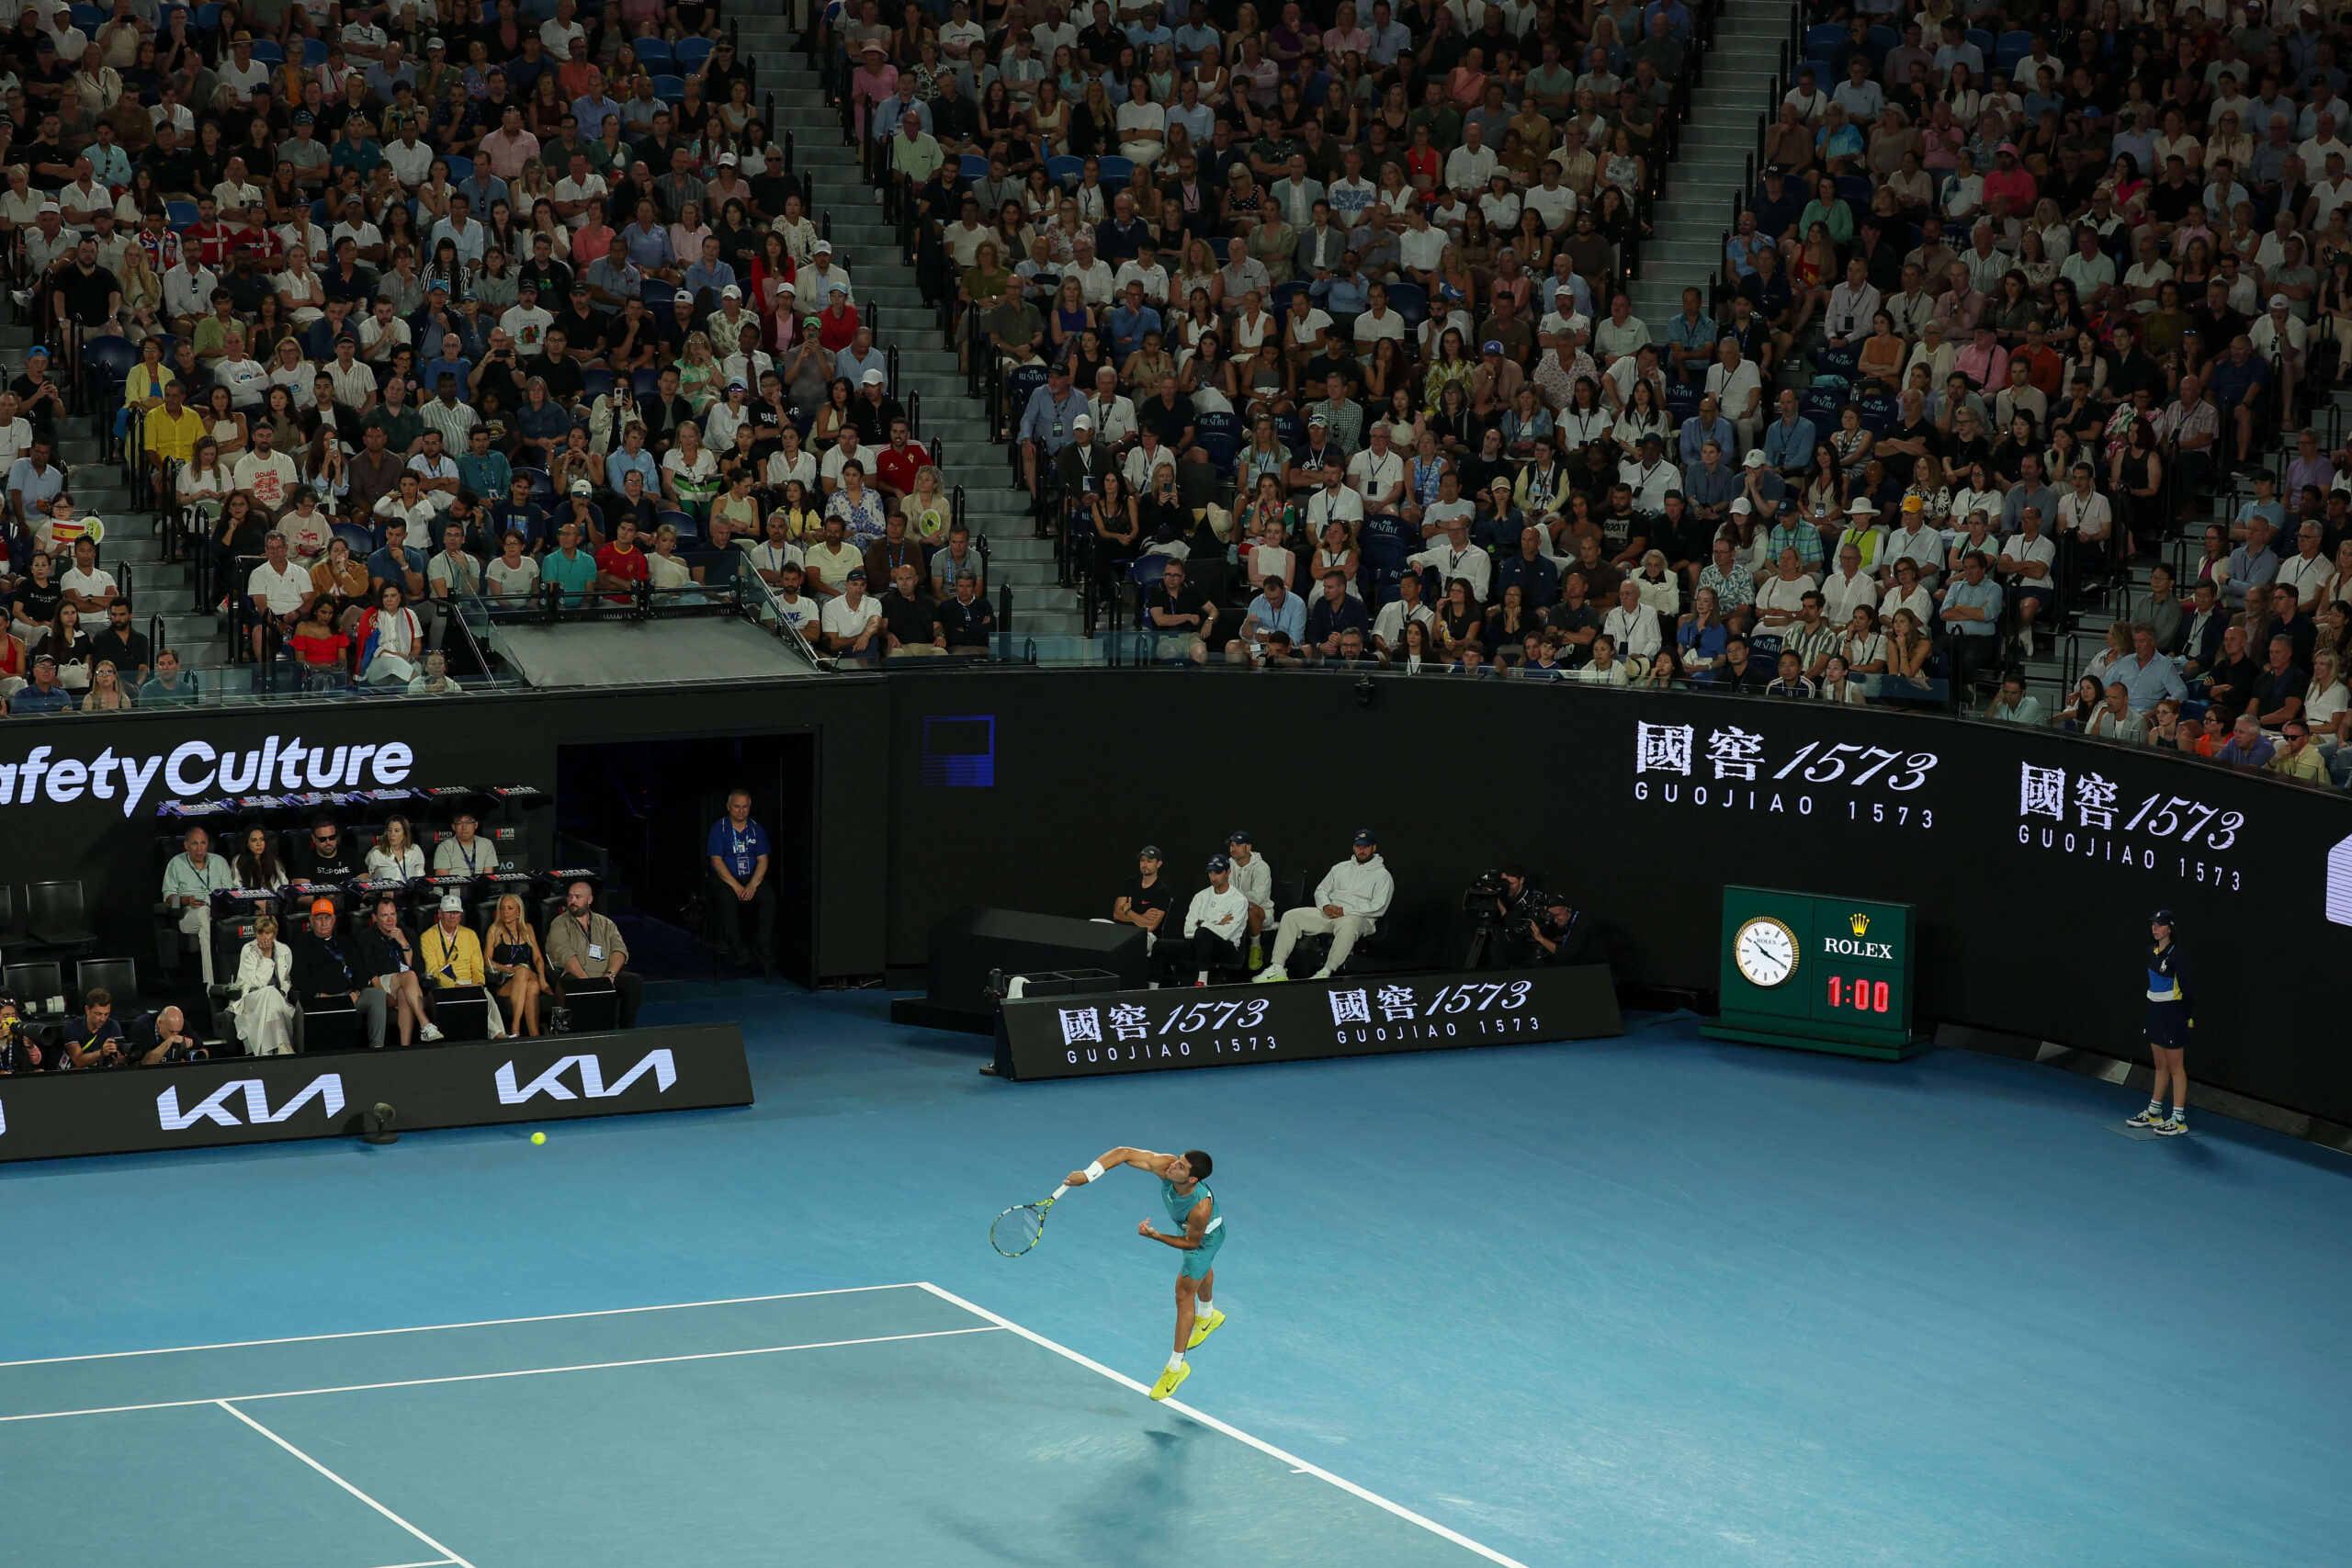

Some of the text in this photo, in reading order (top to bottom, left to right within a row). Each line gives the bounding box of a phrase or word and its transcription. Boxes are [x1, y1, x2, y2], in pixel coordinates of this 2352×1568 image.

[1605, 522, 1627, 532] ROCKY
[1634, 781, 1933, 829] GUOJIAO 1573
[2018, 824, 2241, 891] GUOJIAO 1573
[1824, 937, 1894, 960] ROLEX
[1827, 976, 1889, 1013] 1:00
[1337, 1017, 1539, 1044] GUOJIAO 1573
[1067, 1035, 1276, 1064] GUOJIAO 1573
